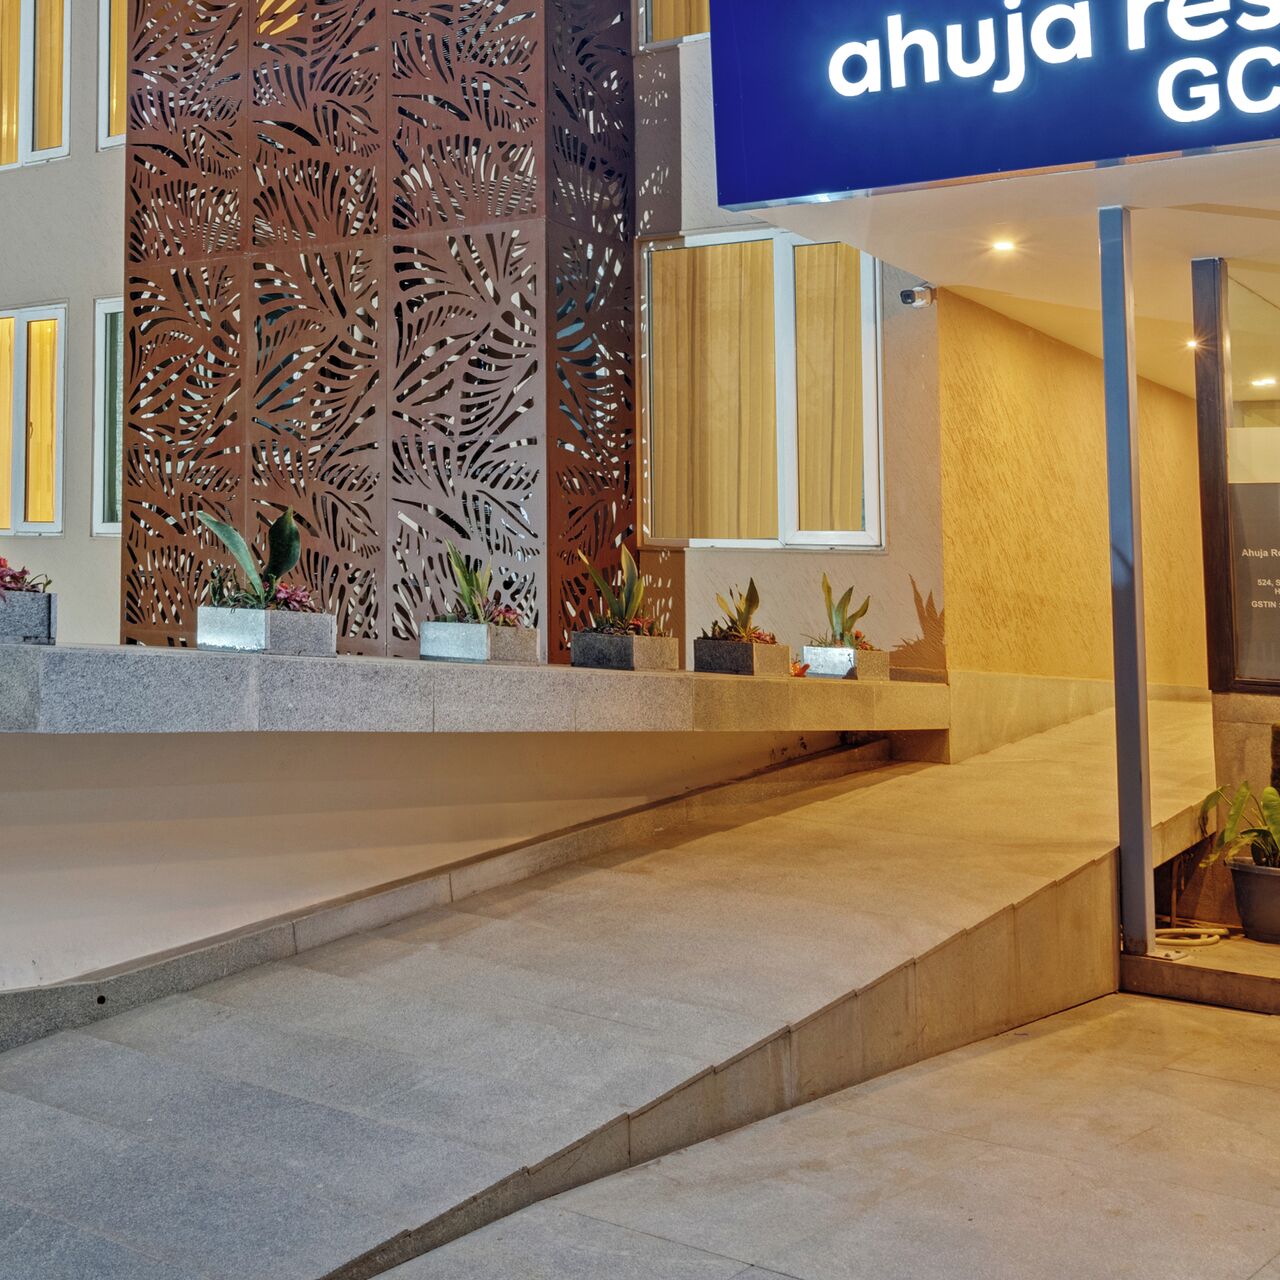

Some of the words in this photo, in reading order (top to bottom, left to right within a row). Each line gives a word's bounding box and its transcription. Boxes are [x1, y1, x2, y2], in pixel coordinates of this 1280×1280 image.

[1241, 548, 1269, 559] Ahuja
[1257, 579, 1274, 587] 524,
[1251, 600, 1277, 608] GSTIN
